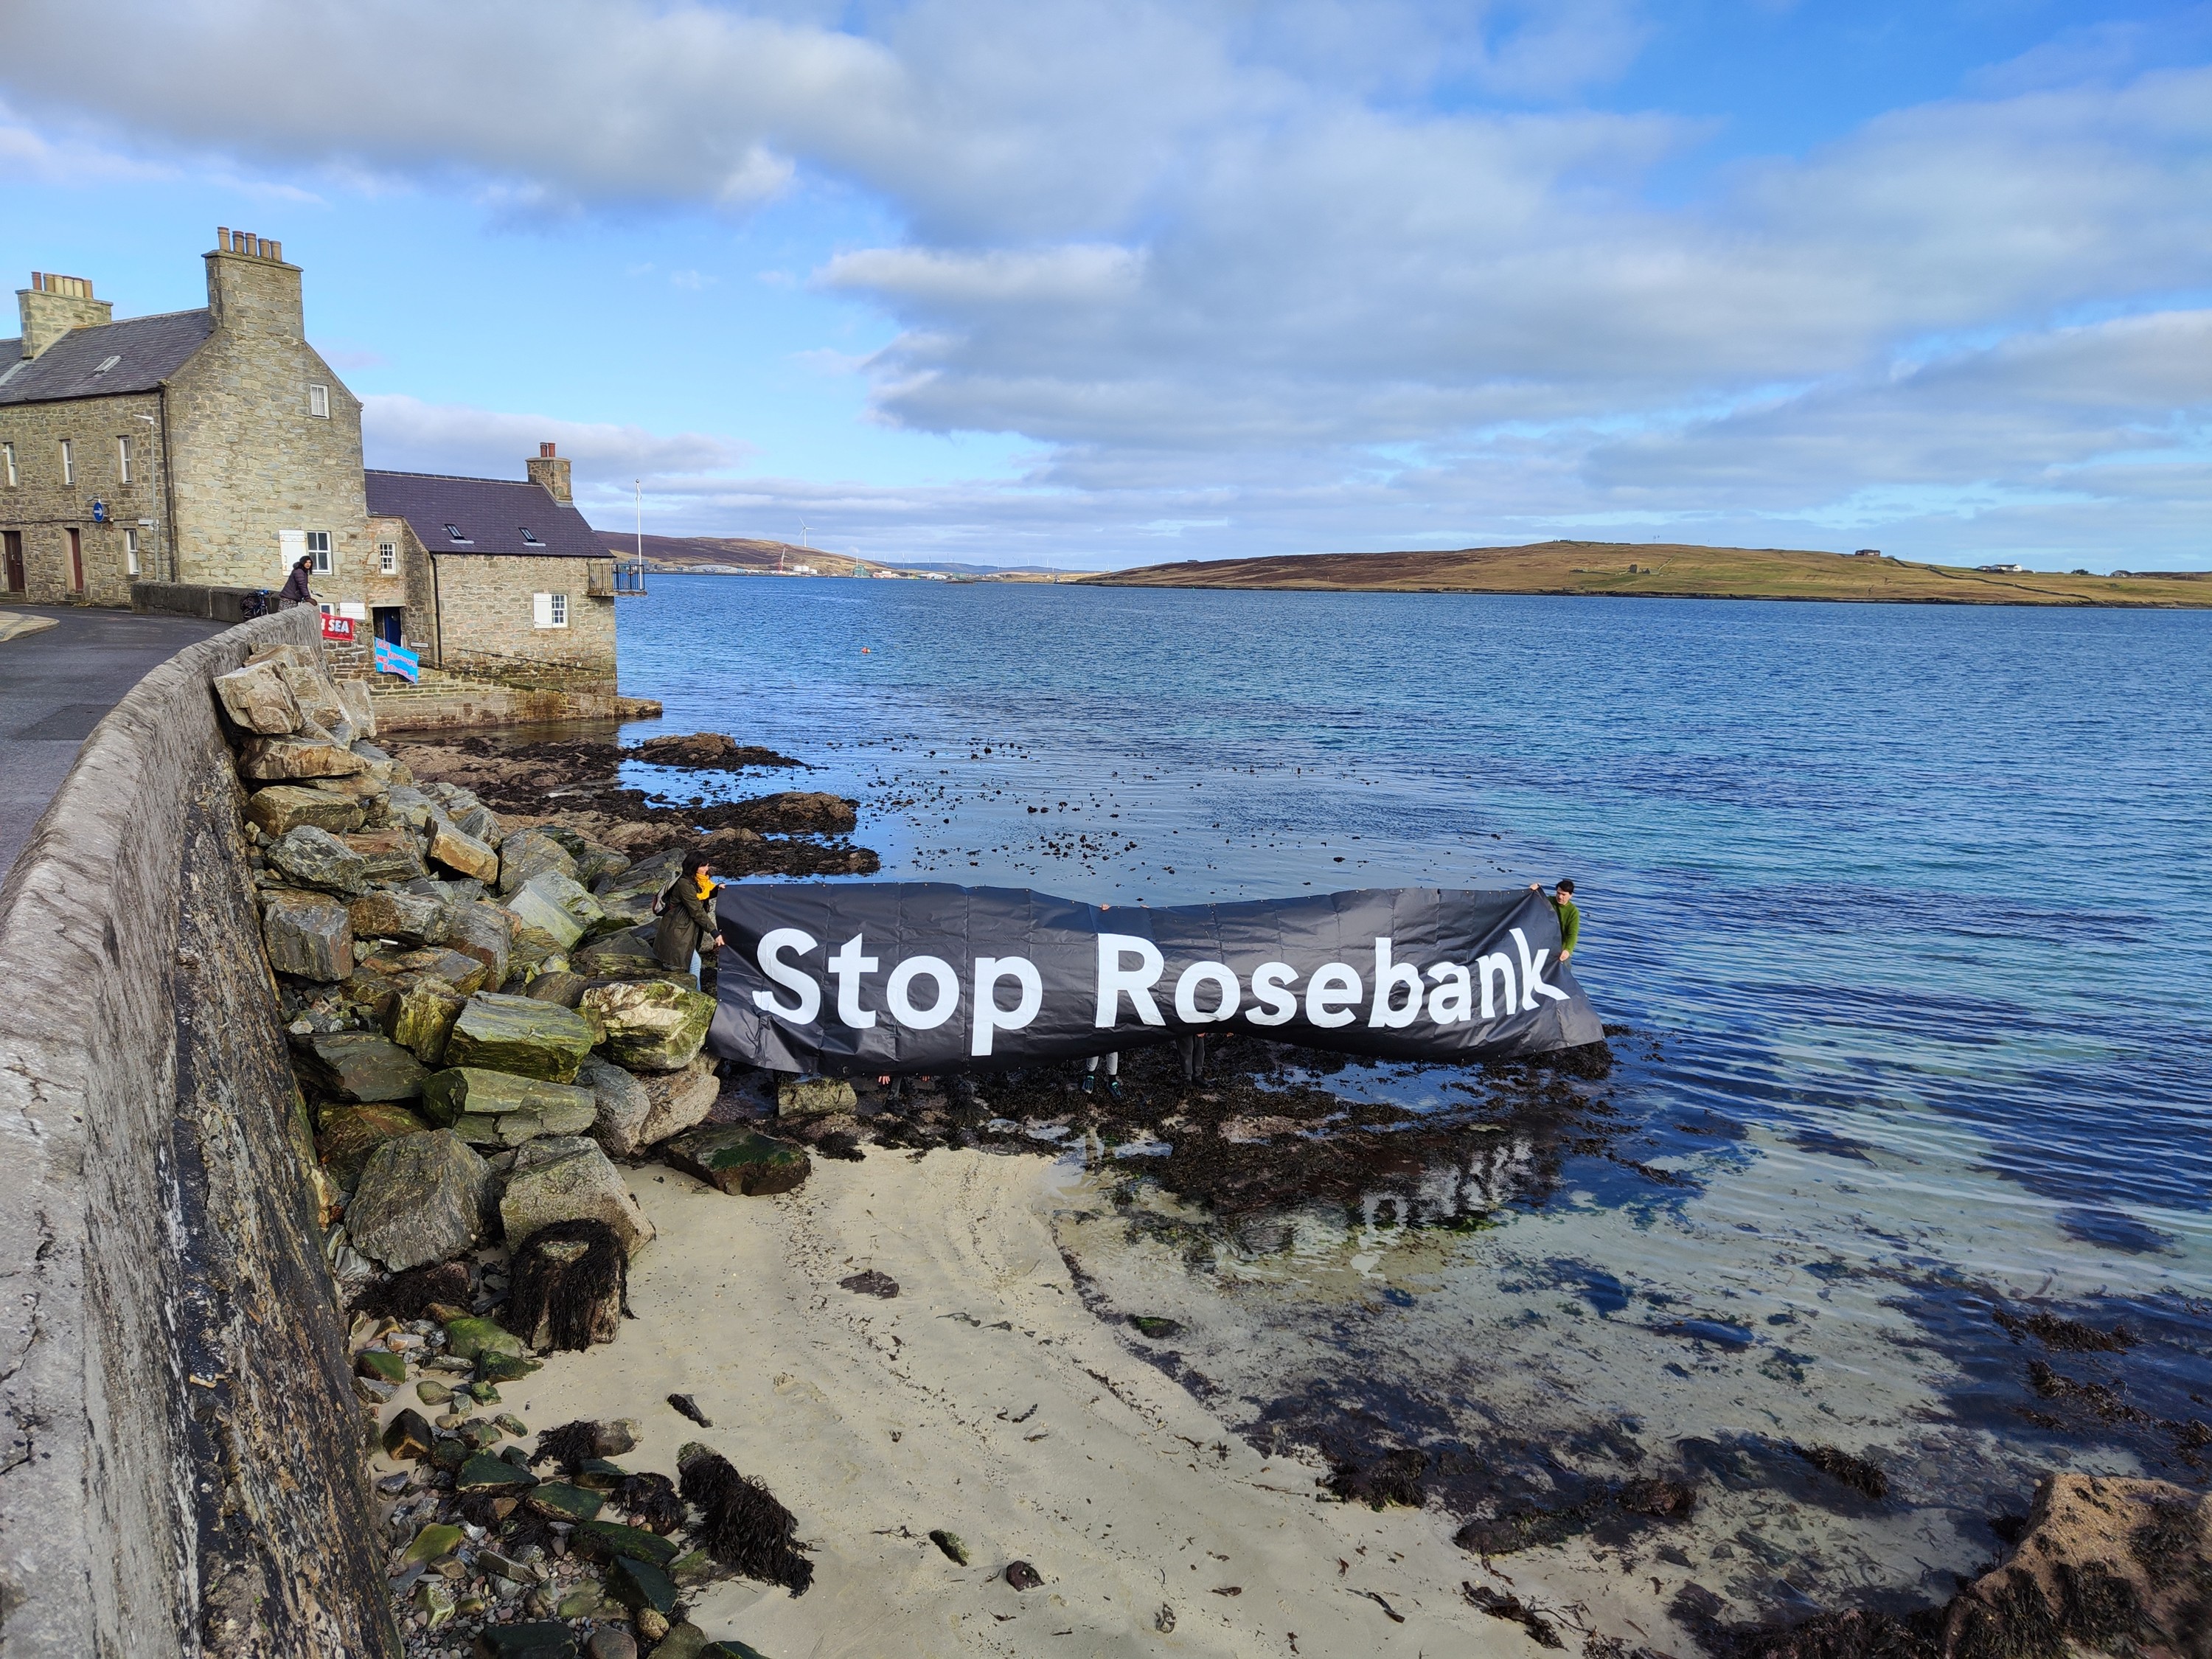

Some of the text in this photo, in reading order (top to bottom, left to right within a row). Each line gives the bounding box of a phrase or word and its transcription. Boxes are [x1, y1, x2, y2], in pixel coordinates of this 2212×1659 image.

[328, 619, 349, 633] SEA
[752, 928, 1571, 1057] Stop Rosebank
